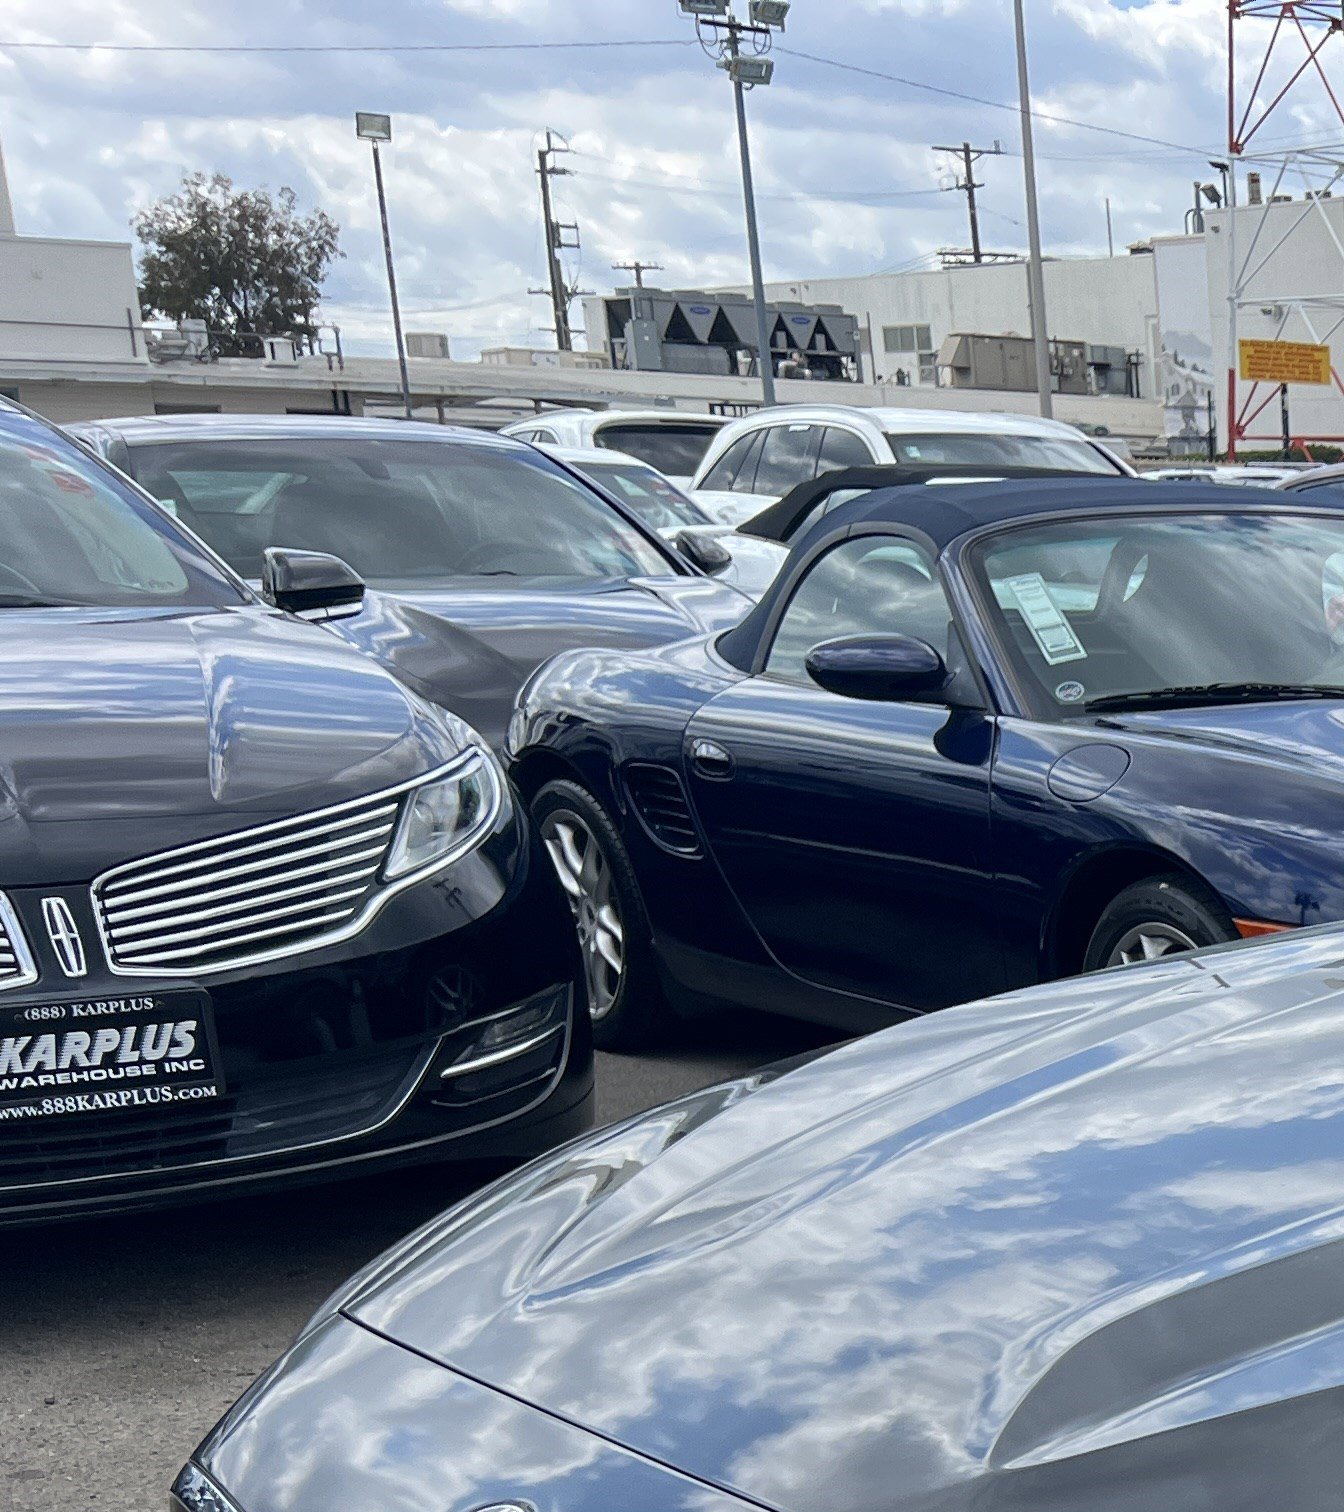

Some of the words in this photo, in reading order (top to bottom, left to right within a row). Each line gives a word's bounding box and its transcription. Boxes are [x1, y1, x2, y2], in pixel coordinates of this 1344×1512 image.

[23, 1005, 66, 1021] (888)
[71, 997, 154, 1017] KARPLUS
[0, 1019, 197, 1075] KARPLUS
[0, 1063, 157, 1091] WAREHOUSE
[164, 1058, 205, 1073] INC
